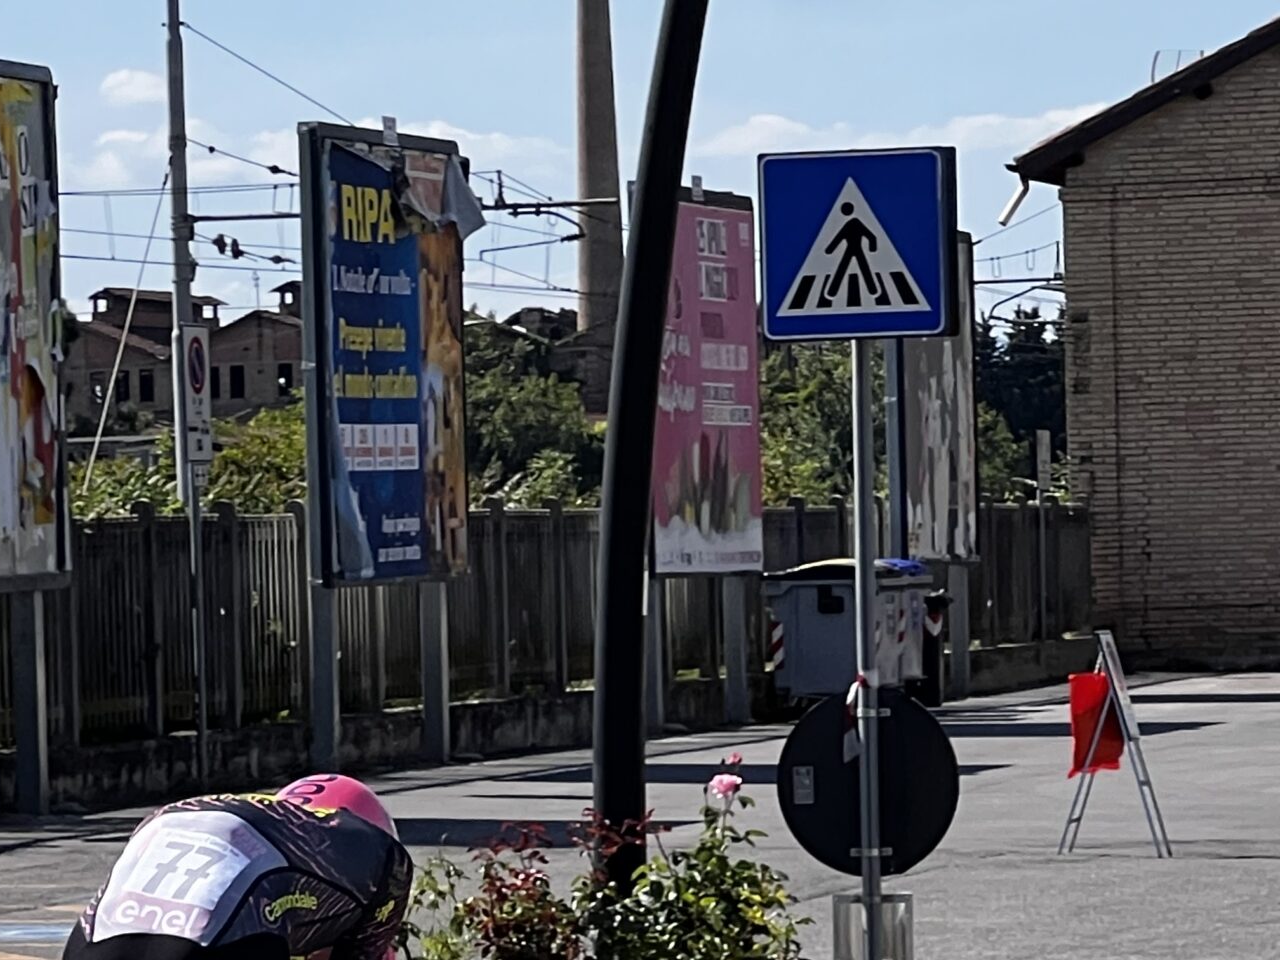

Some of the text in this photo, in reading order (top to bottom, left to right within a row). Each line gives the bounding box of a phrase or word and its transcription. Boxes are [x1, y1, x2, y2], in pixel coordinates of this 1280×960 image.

[341, 184, 396, 245] RIPA
[141, 840, 228, 900] 77
[115, 899, 200, 938] enel
